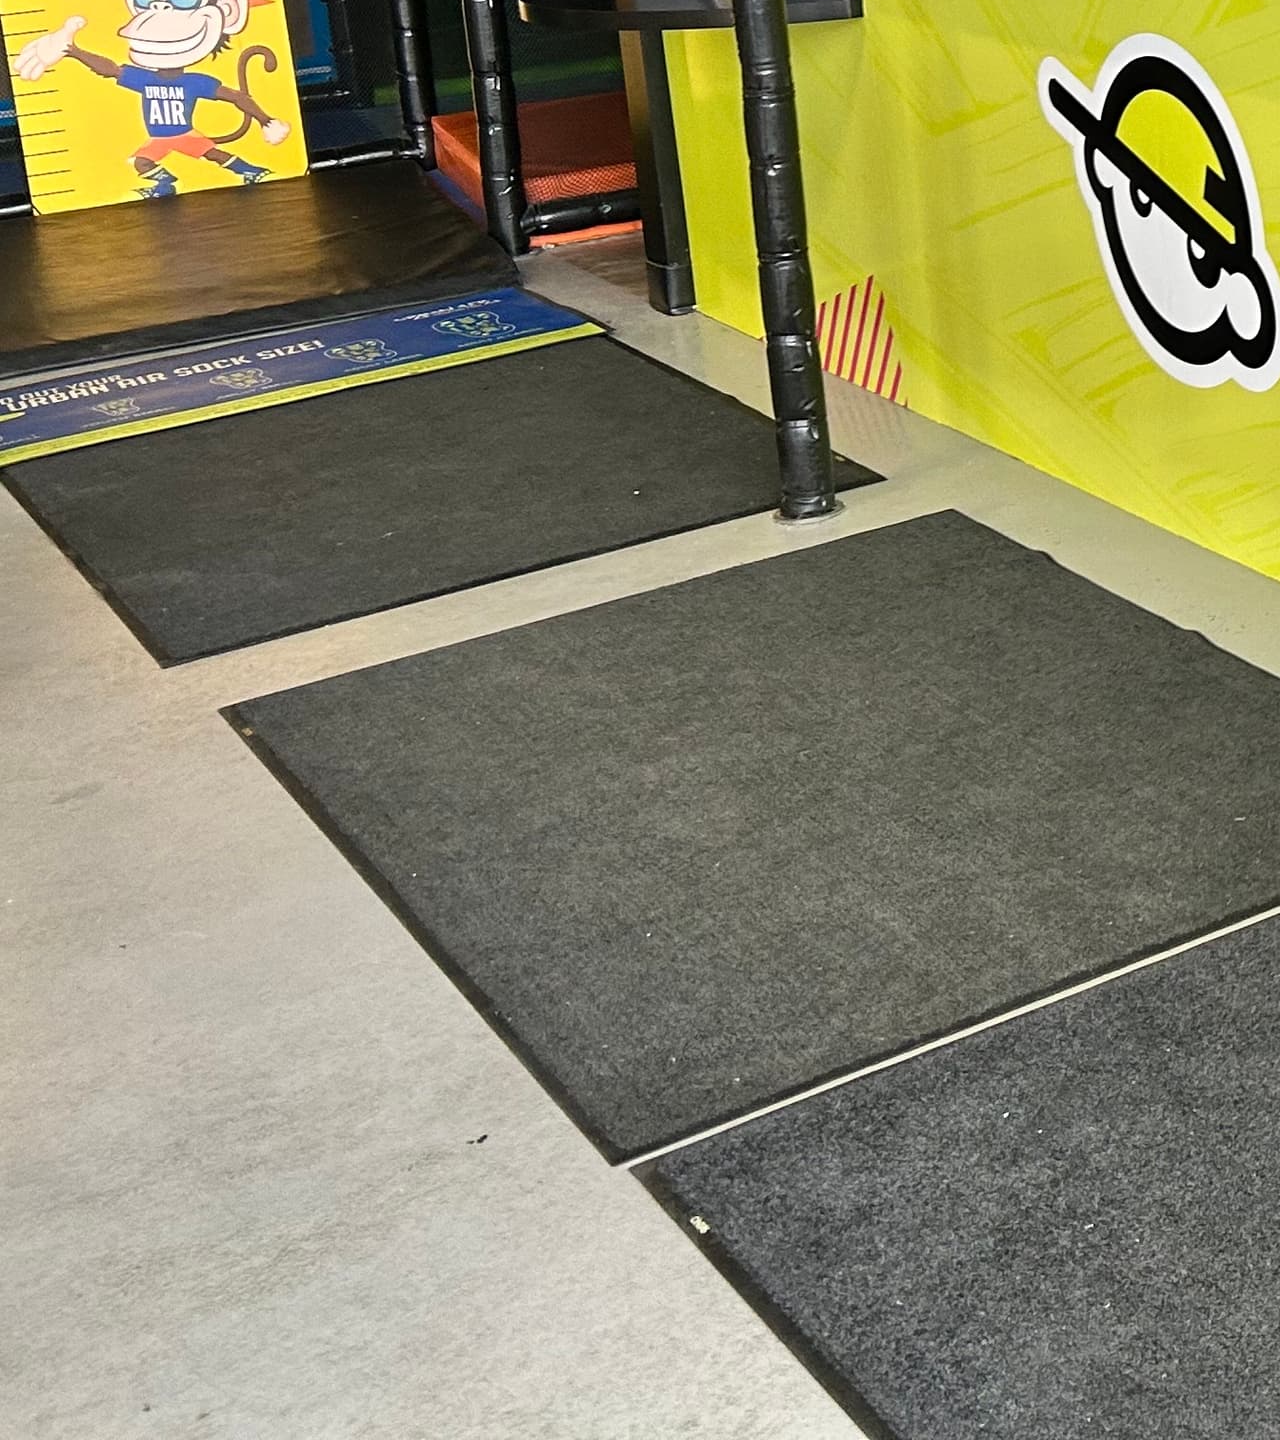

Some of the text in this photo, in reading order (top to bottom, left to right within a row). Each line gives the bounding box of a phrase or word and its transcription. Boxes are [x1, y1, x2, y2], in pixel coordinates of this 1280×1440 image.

[144, 86, 184, 100] URBAN
[149, 99, 187, 125] AIR
[6, 339, 325, 412] URBAN AIR SOCK SIZE!
[19, 387, 59, 400] OUT
[65, 374, 122, 390] YOUR
